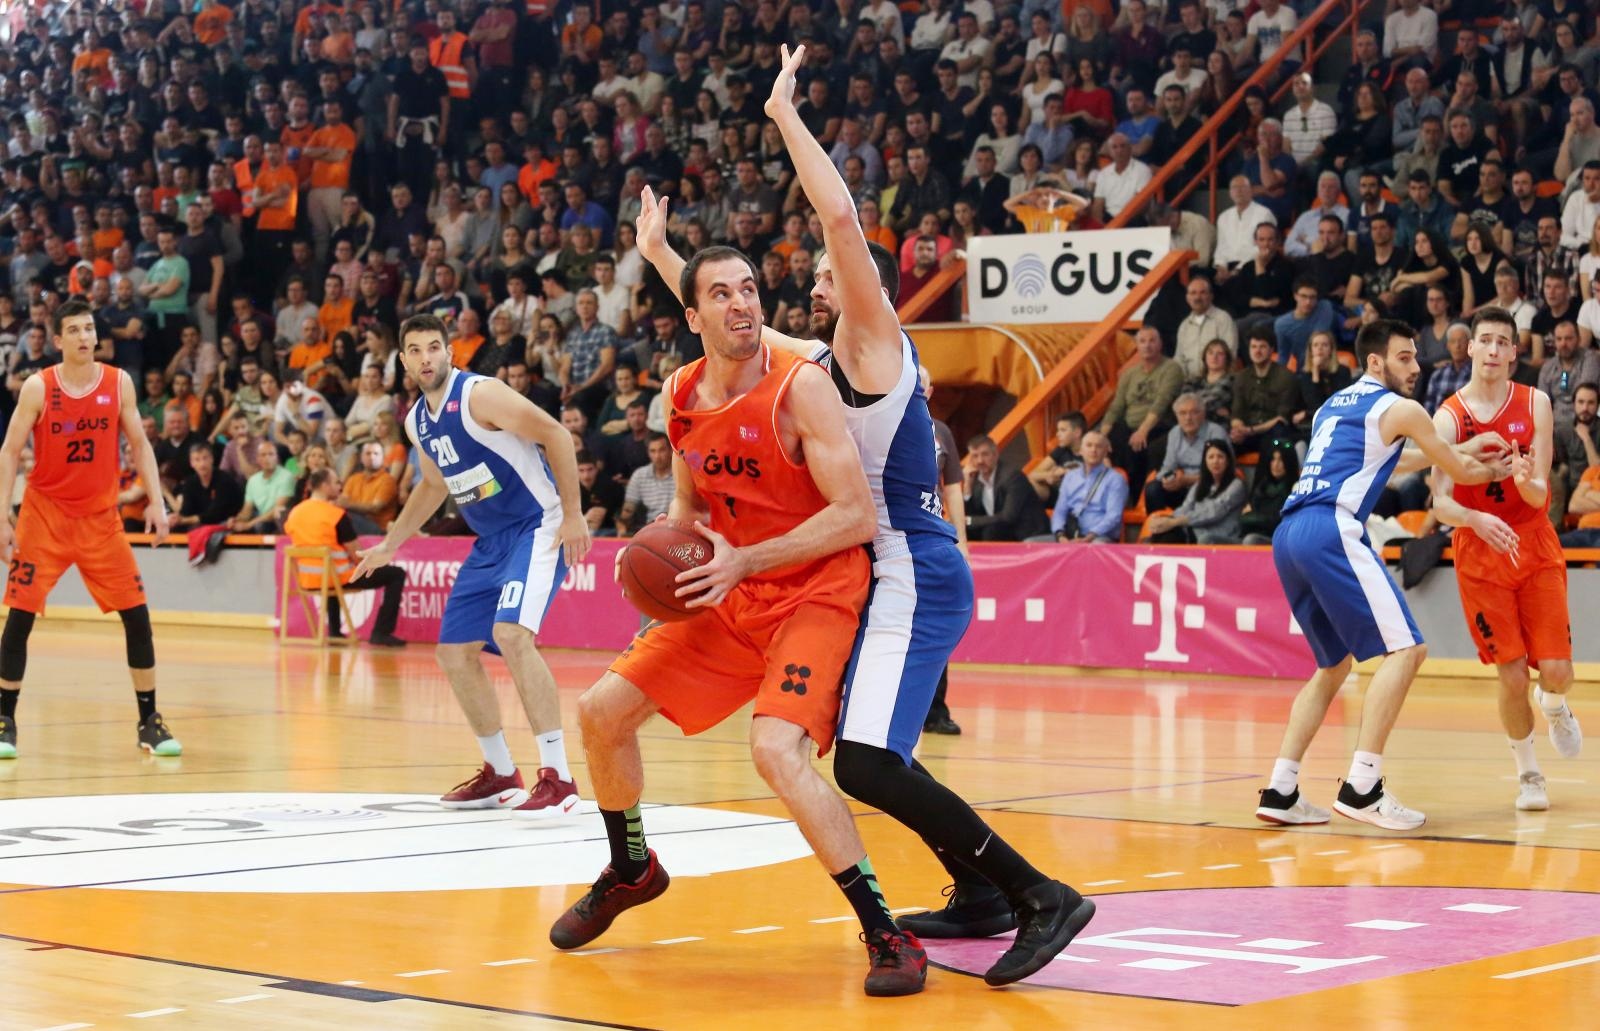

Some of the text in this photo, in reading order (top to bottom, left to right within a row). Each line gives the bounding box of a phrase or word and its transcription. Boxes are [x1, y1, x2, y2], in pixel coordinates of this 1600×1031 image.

[1011, 305, 1049, 315] GROUP
[66, 438, 95, 464] 23
[429, 434, 460, 468] 20
[1305, 415, 1343, 463] 4
[1485, 480, 1505, 503] 4
[9, 559, 35, 586] 23
[389, 560, 463, 588] RVATS
[560, 563, 596, 592] OM
[399, 591, 449, 618] REMI
[1133, 554, 1206, 663] T
[1475, 611, 1493, 639] 4
